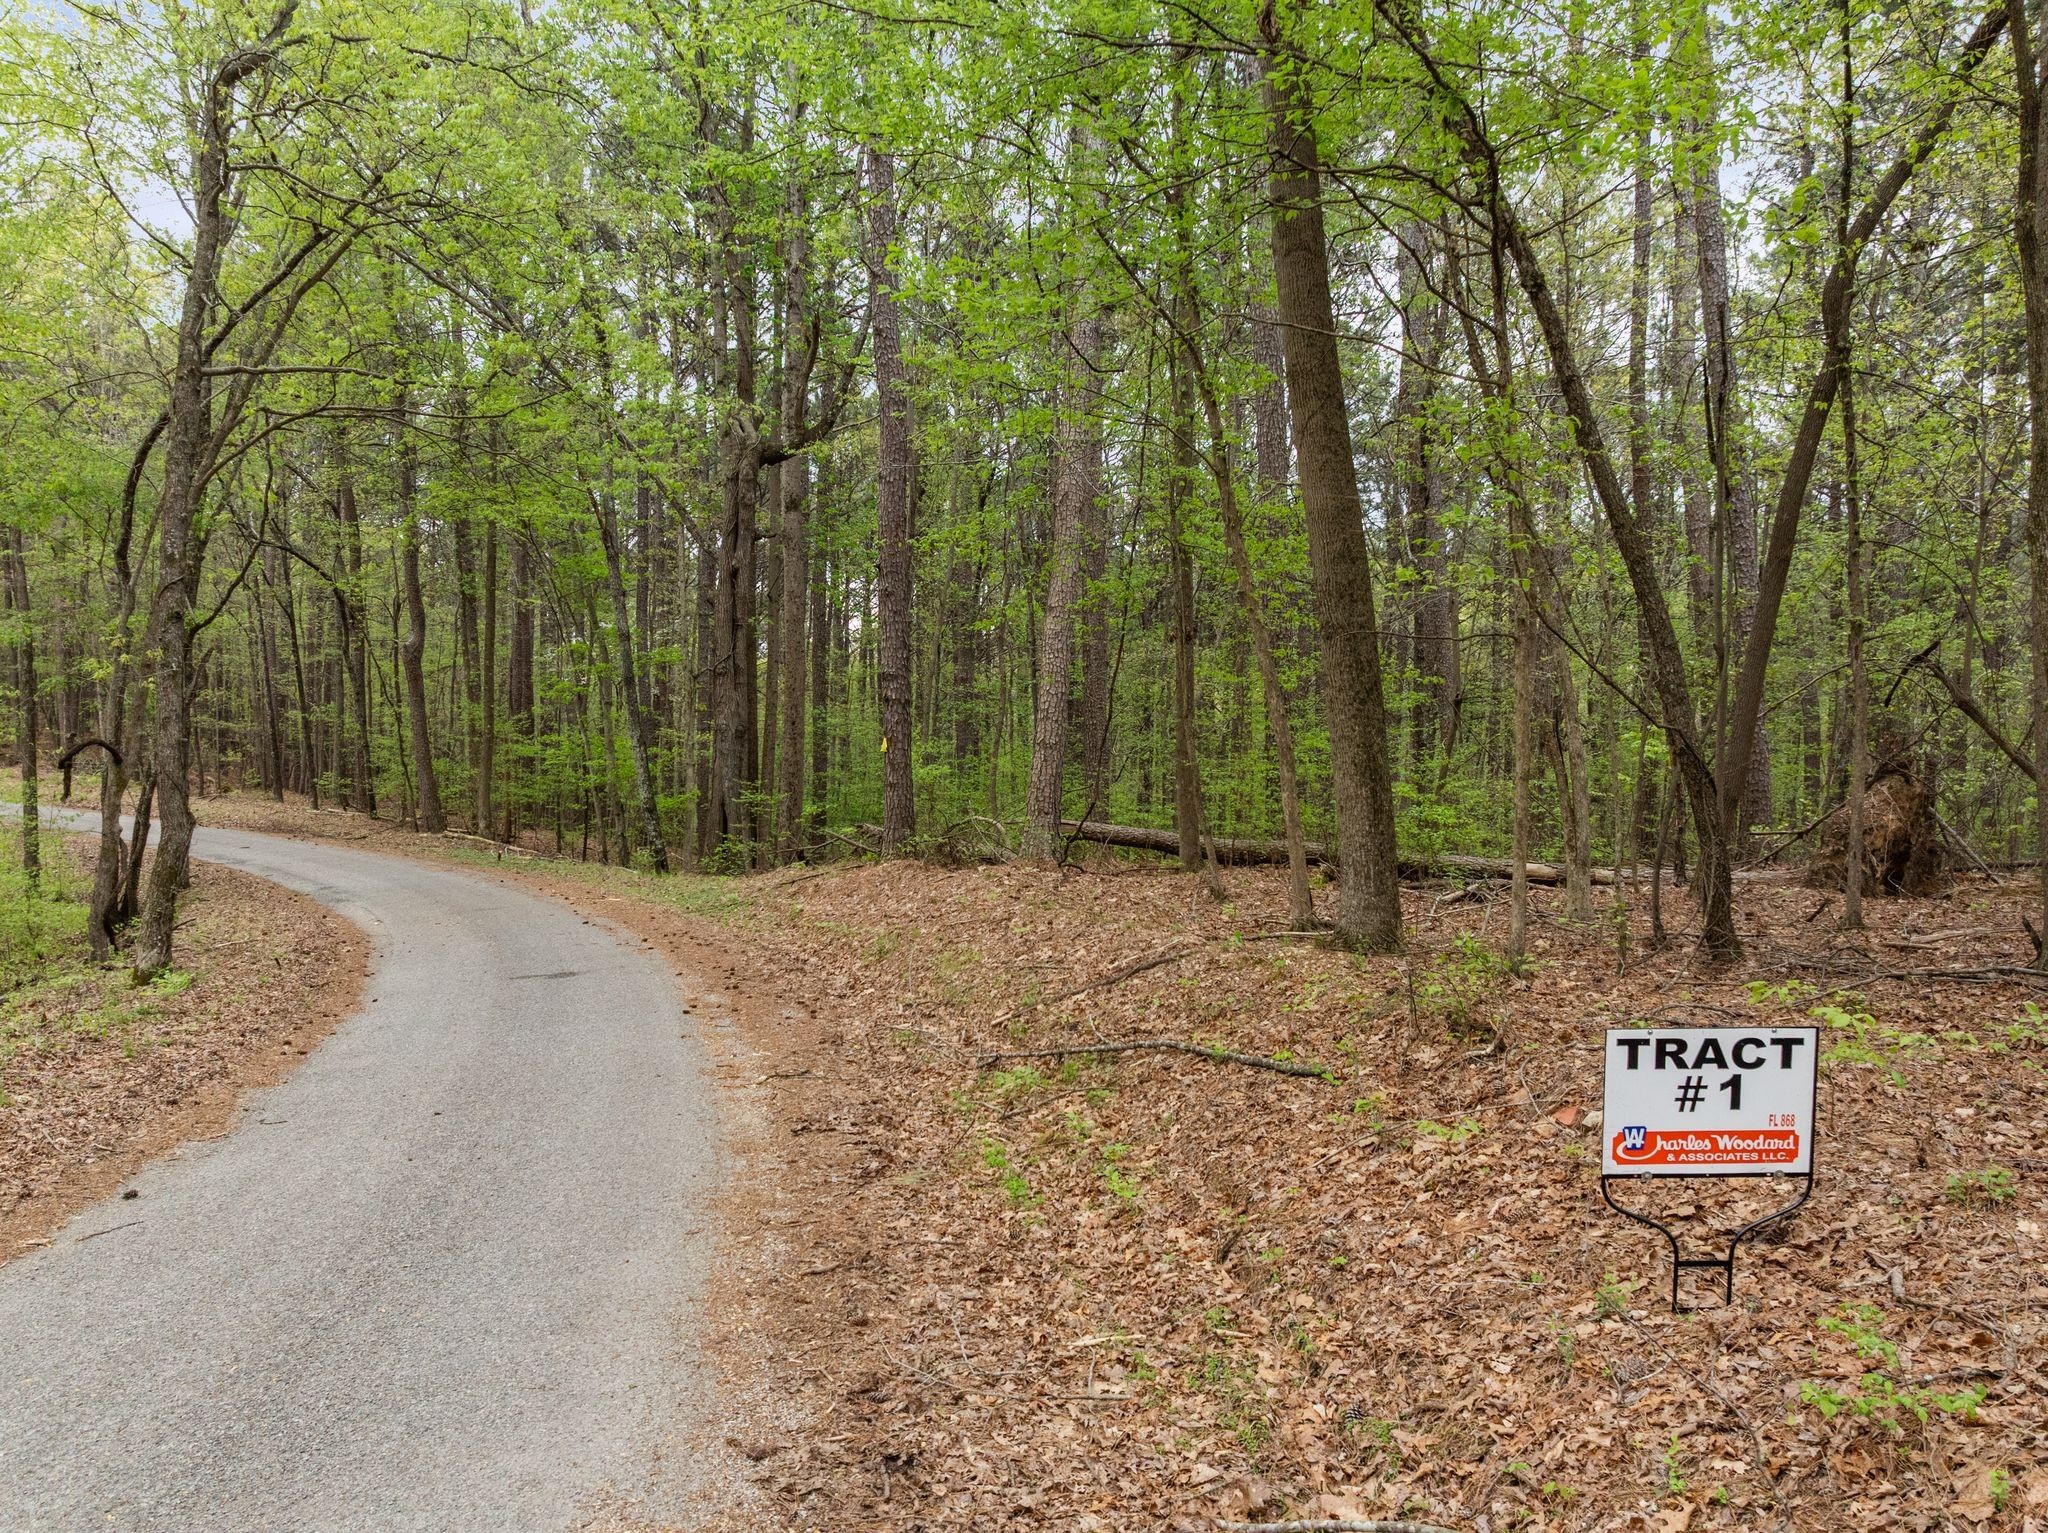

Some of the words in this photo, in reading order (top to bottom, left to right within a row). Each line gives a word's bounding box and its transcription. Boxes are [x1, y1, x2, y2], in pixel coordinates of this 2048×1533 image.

[1616, 1037, 1805, 1070] TRACT
[1768, 1114, 1778, 1127] FL
[1780, 1113, 1796, 1127] 868
[1710, 1134, 1796, 1151] Woodard
[1666, 1153, 1676, 1162] &
[1678, 1152, 1759, 1162] ASSOCIATES
[1761, 1150, 1790, 1161] LLC.
